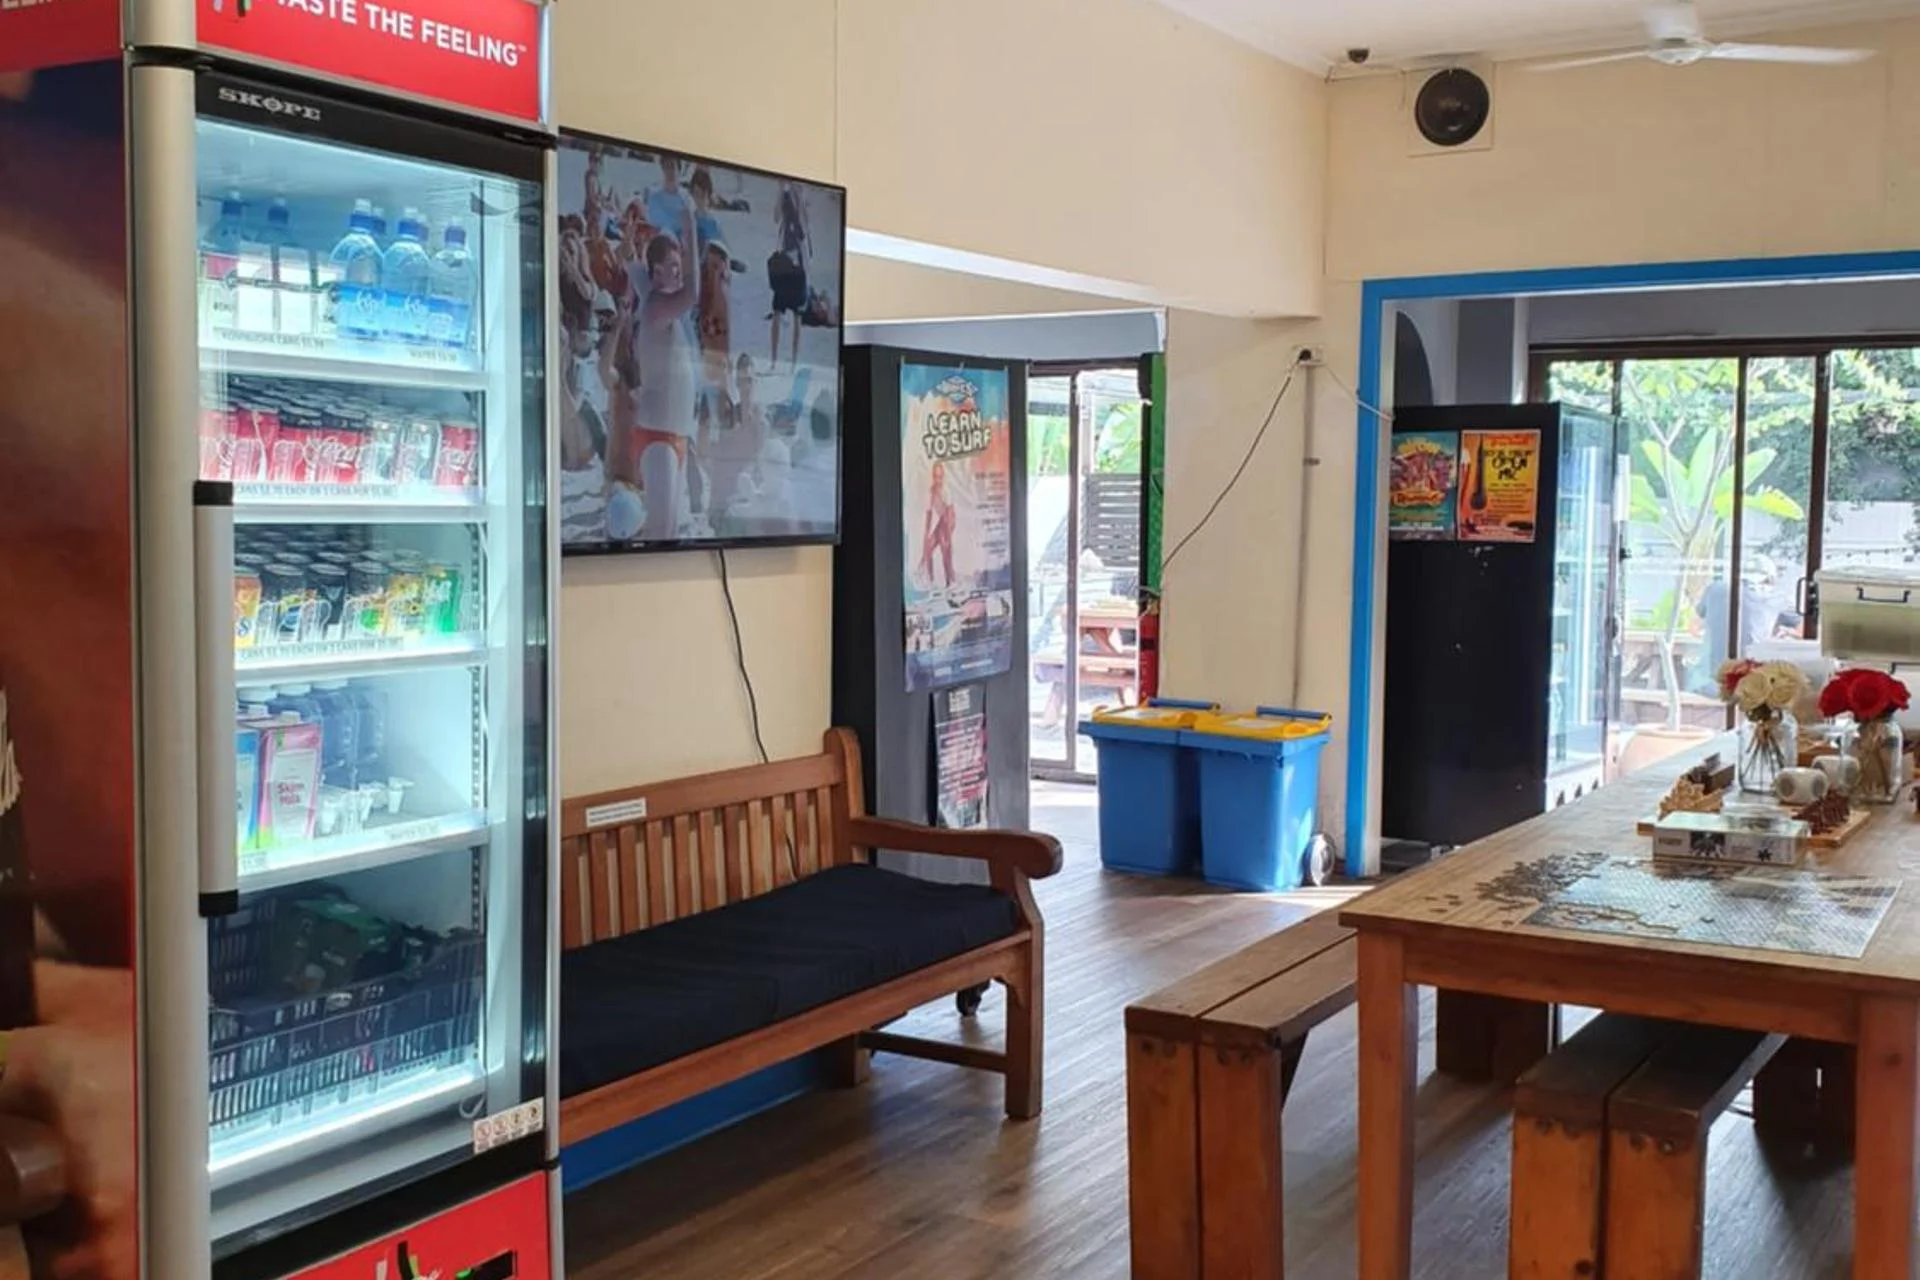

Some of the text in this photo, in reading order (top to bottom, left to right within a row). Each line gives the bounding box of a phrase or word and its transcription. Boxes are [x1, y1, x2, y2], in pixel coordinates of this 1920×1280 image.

[278, 0, 519, 67] STE THE FEELING
[218, 86, 321, 120] SKOPE
[927, 410, 981, 436] LEARN
[922, 427, 992, 457] TO SURF
